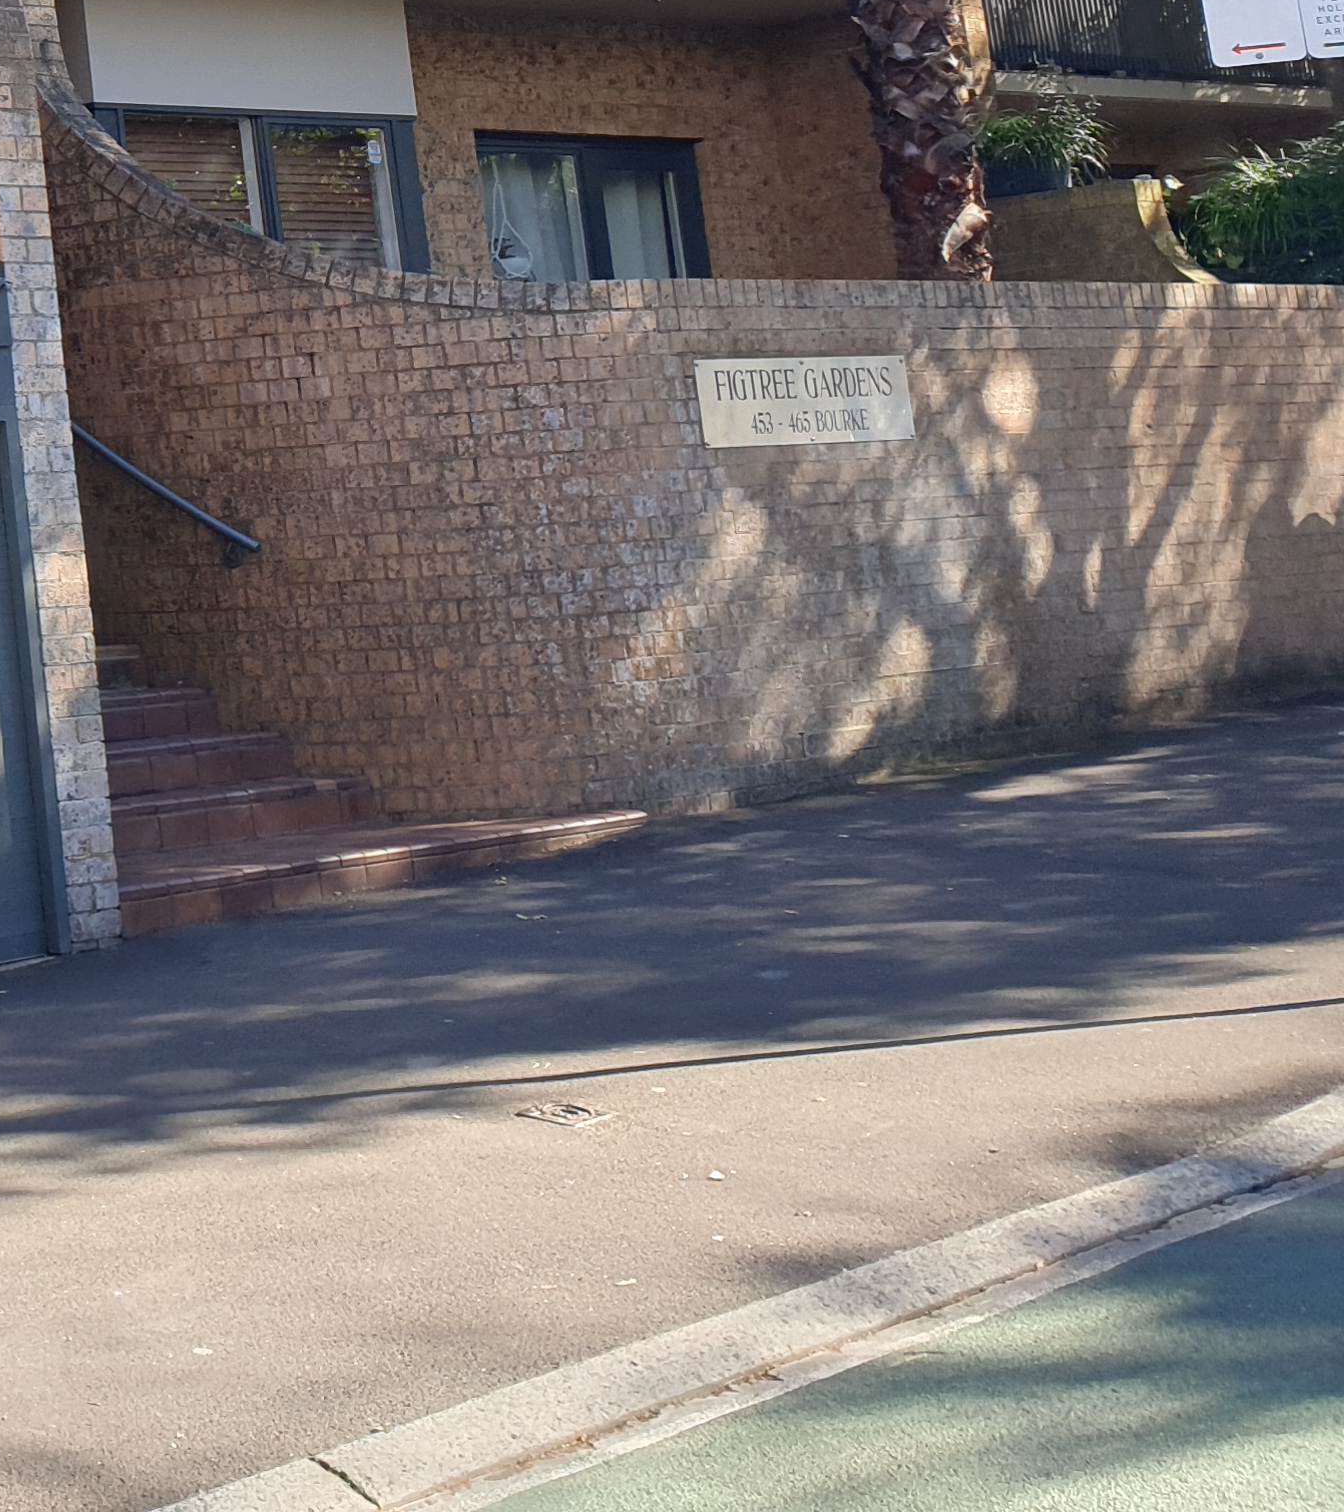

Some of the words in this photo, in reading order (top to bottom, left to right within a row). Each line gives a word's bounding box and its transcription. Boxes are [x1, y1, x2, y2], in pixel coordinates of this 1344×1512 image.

[1317, 3, 1344, 13] HOL
[714, 368, 798, 401] FIGTREE
[804, 366, 893, 399] GARDENS
[751, 411, 774, 434] 453
[788, 410, 811, 433] 465
[815, 408, 870, 432] BOURKE
